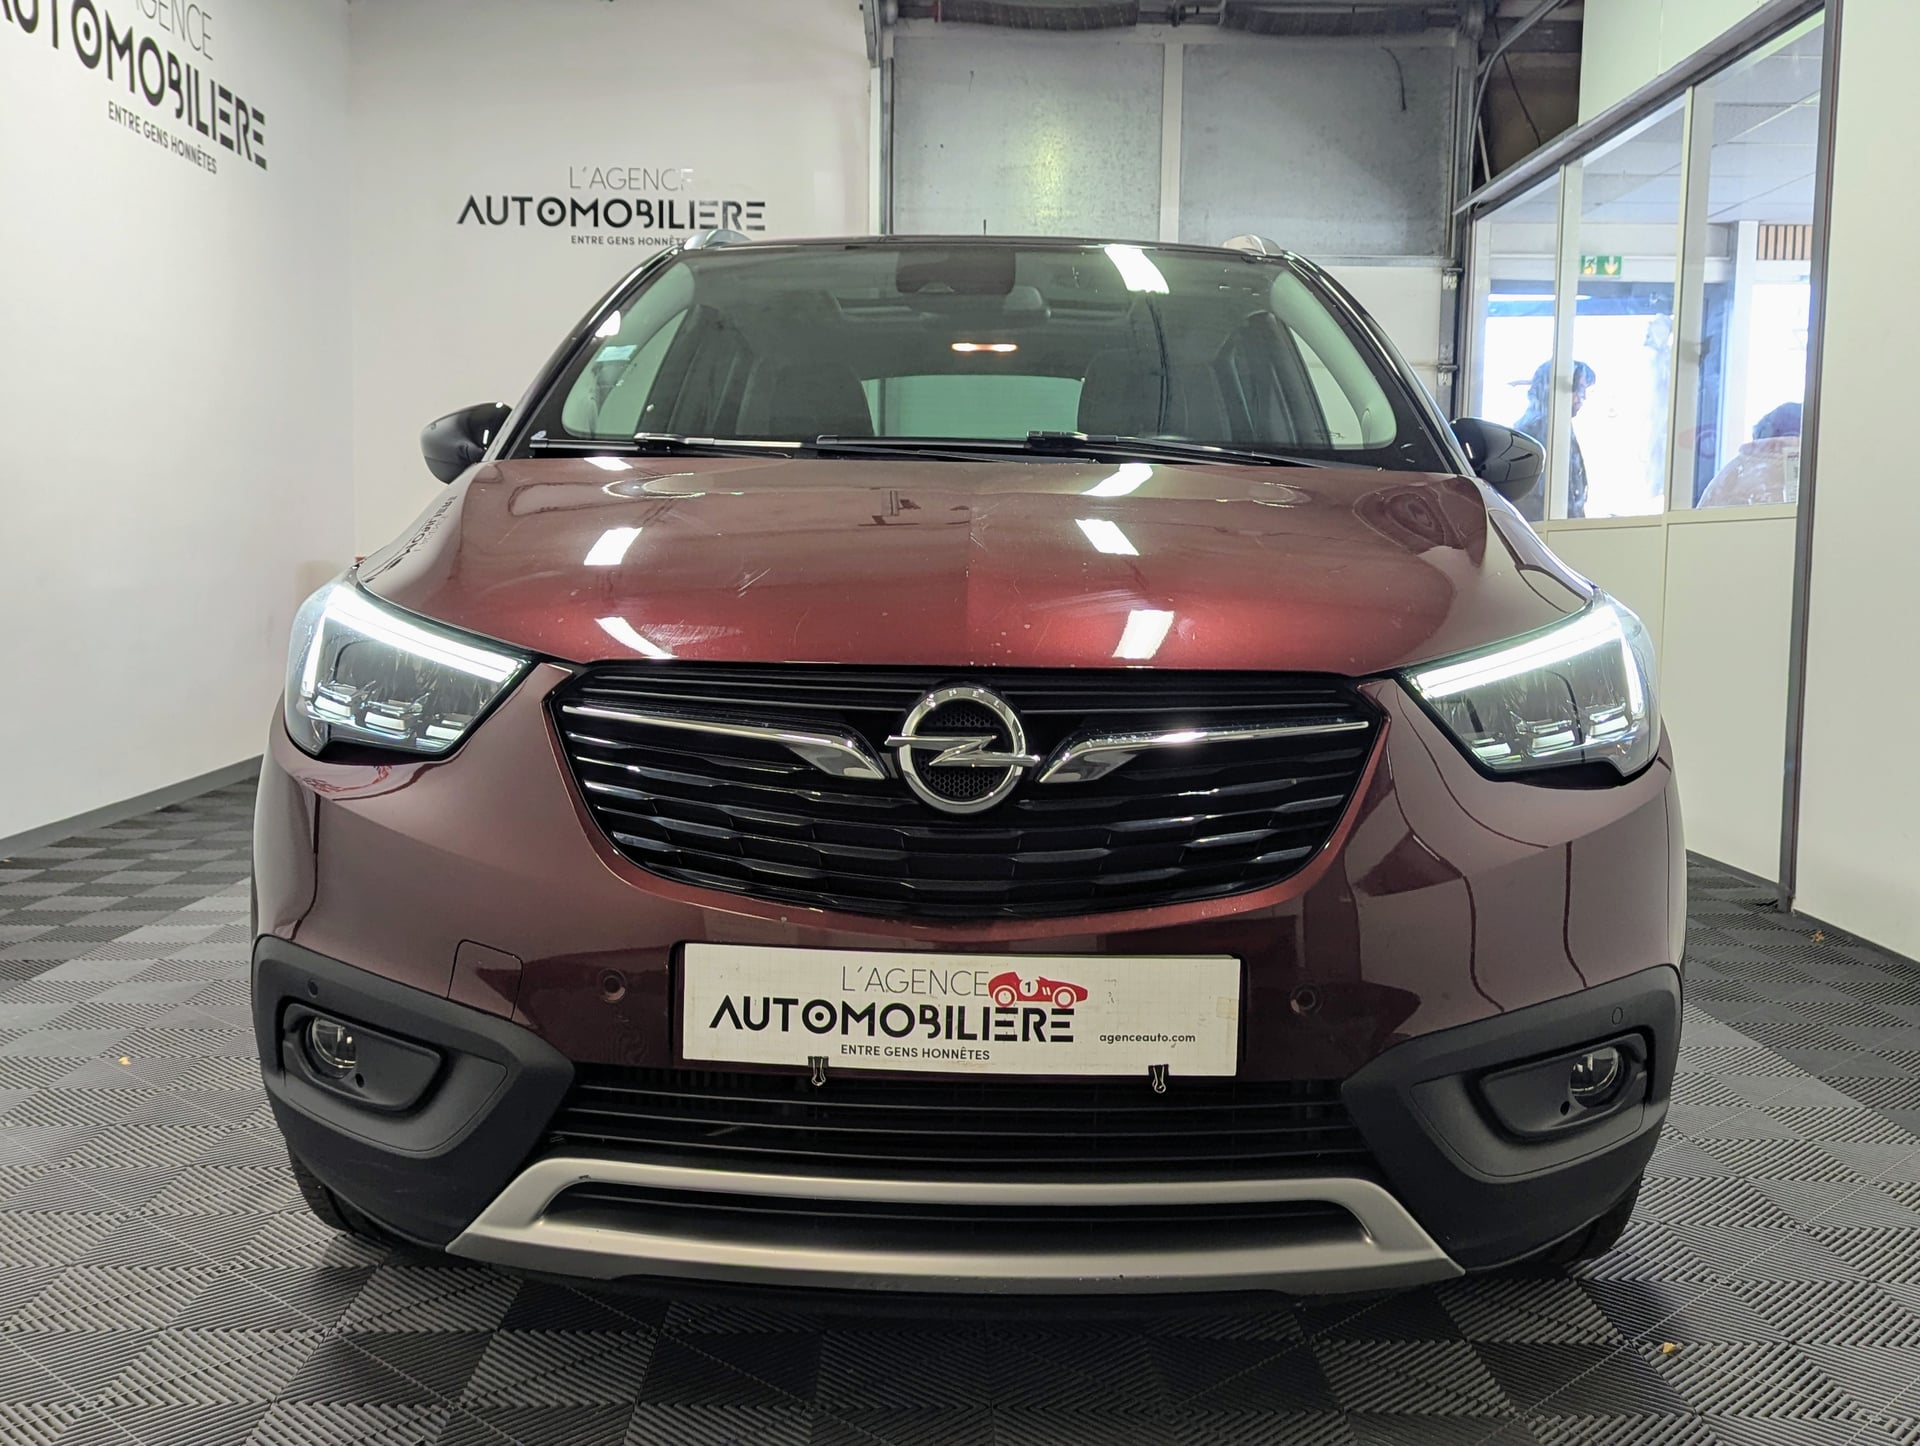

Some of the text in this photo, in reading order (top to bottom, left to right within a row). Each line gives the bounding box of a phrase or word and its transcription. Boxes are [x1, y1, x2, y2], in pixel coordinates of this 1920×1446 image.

[108, 100, 217, 175] ENTRE GENS HONNÊTES
[571, 235, 604, 245] ENTRE
[607, 236, 636, 246] GENS
[841, 966, 990, 997] L'AGENCE
[708, 994, 1075, 1043] AUTOMOBILIERE
[1099, 1033, 1196, 1045] agenceauto.com
[841, 1044, 990, 1060] ENTRE GENS HONNÊTES
